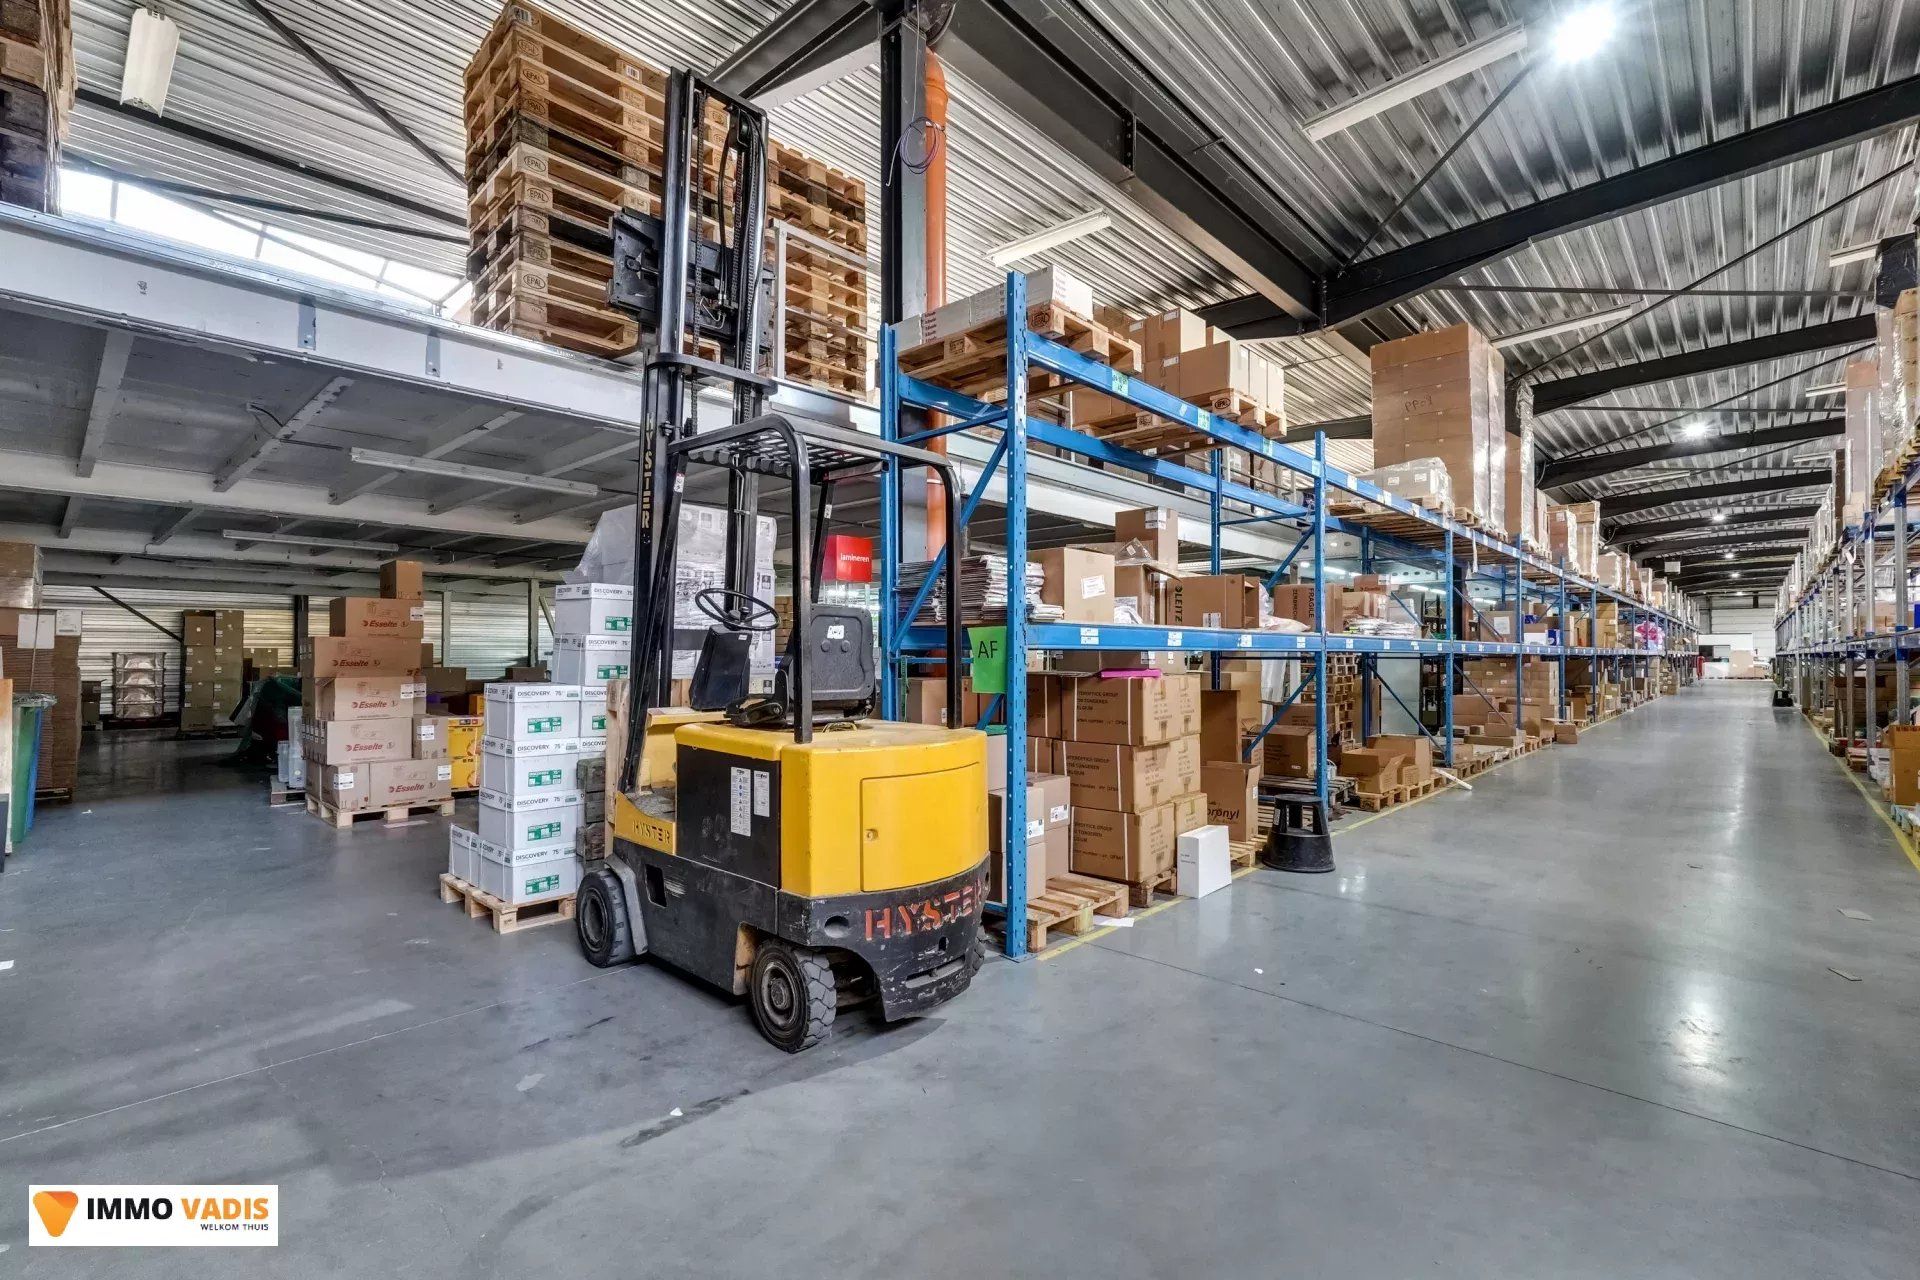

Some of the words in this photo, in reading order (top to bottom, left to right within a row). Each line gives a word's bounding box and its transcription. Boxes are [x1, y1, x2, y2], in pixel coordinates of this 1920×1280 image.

[526, 159, 542, 170] EPAL
[529, 189, 546, 201] EPAL
[526, 275, 541, 287] EPAL
[641, 412, 654, 529] HYSTER
[1174, 593, 1183, 623] LEITZ
[978, 640, 998, 659] AF
[339, 659, 369, 667] Esselte
[359, 700, 387, 708] Esselte
[353, 743, 383, 751] Esselte
[395, 784, 424, 793] Esselte
[516, 798, 549, 806] DISCOVERY
[515, 850, 548, 860] DISCOVERY
